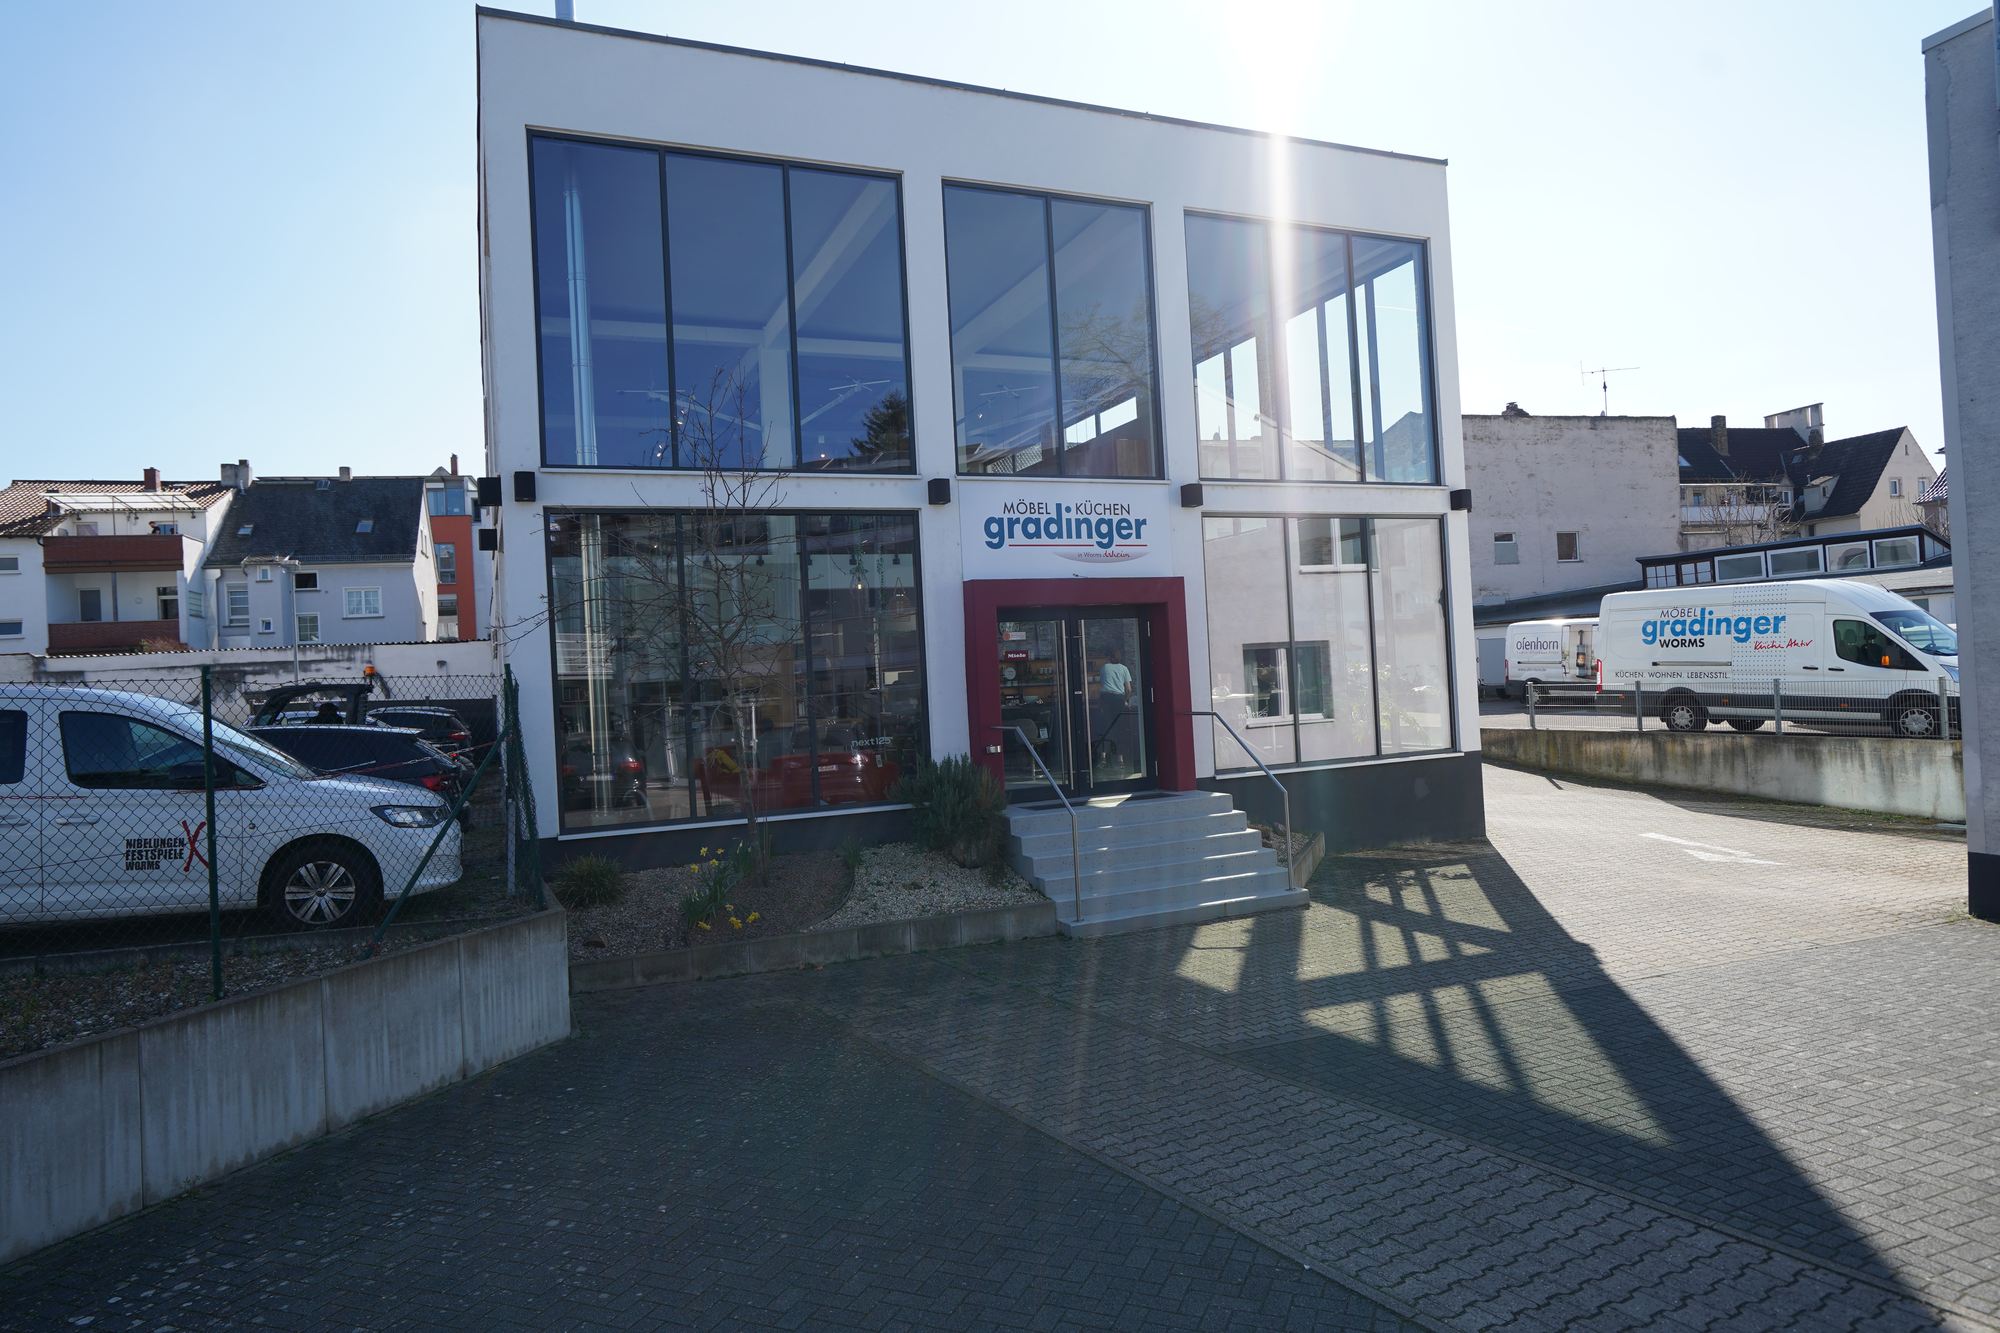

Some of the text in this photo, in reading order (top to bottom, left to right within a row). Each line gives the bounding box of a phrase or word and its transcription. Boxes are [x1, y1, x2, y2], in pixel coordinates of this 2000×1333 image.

[1003, 499, 1131, 516] MÖBEL KÜCHEN
[984, 503, 1147, 550] gradinger
[1660, 607, 1698, 618] MÖBEL
[1641, 607, 1786, 645] gradinger
[1659, 638, 1705, 648] WORMS
[1647, 671, 1684, 679] WOHNEN.
[851, 736, 893, 747] next125
[125, 838, 185, 849] NIBELUNGEN
[125, 849, 185, 860] FESTSPIELE
[125, 861, 160, 871] WORMS
